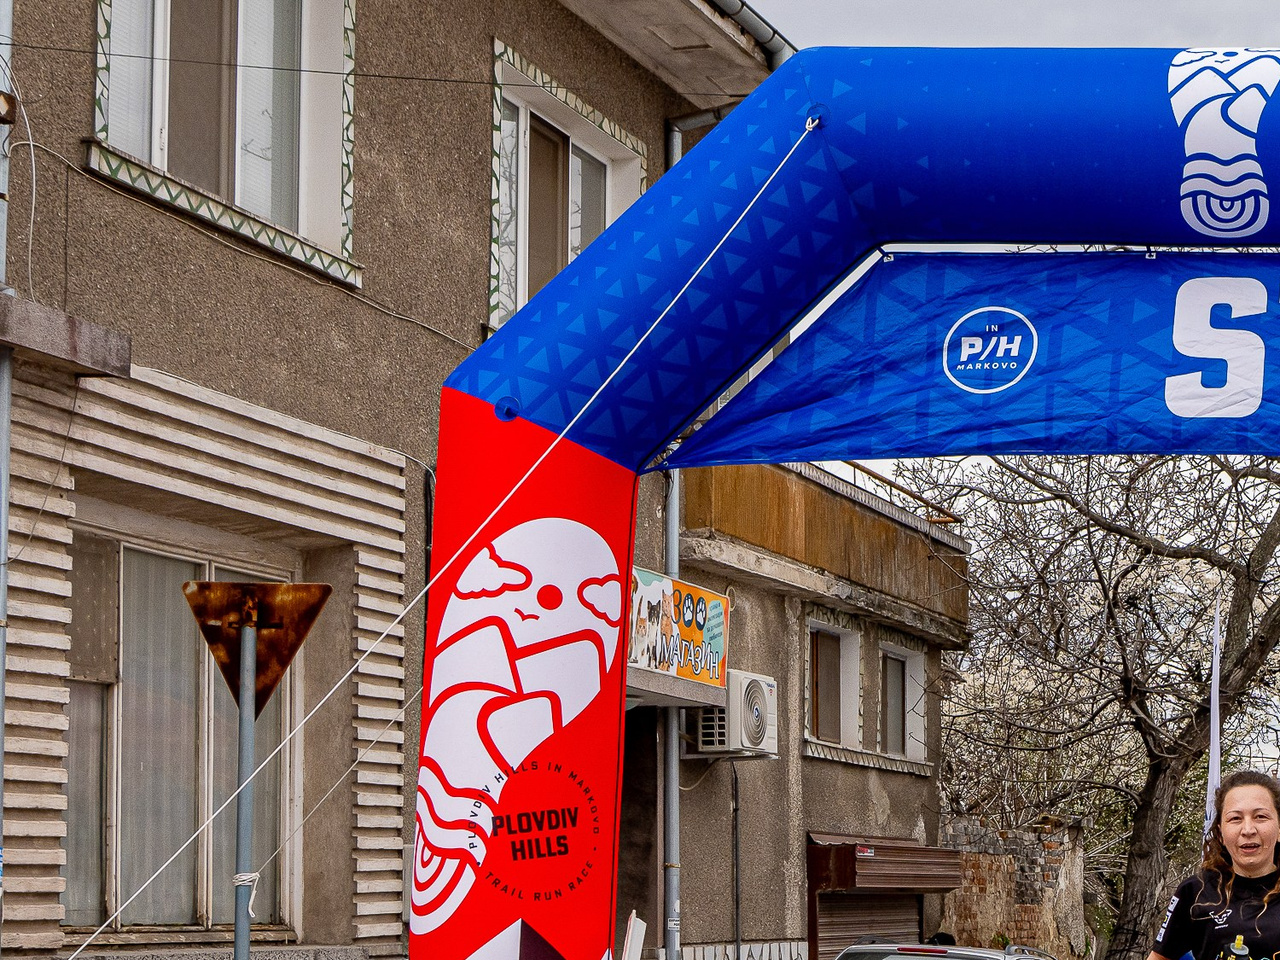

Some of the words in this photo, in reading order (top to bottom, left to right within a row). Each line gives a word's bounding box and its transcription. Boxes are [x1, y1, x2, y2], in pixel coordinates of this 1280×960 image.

[985, 324, 999, 332] IN
[959, 335, 1022, 362] P/H
[956, 361, 1017, 371] MARKOVO
[660, 632, 720, 680] МАГАЗИН
[468, 784, 492, 850] PLOVDIV
[494, 760, 539, 784] HILLS
[547, 761, 563, 773] IN
[567, 770, 600, 835] MARKOVO
[491, 806, 579, 837] PLOVDIV
[510, 834, 570, 862] HILLS
[484, 871, 525, 900] TRAIL
[533, 888, 563, 901] RUN
[567, 860, 594, 891] RACE
